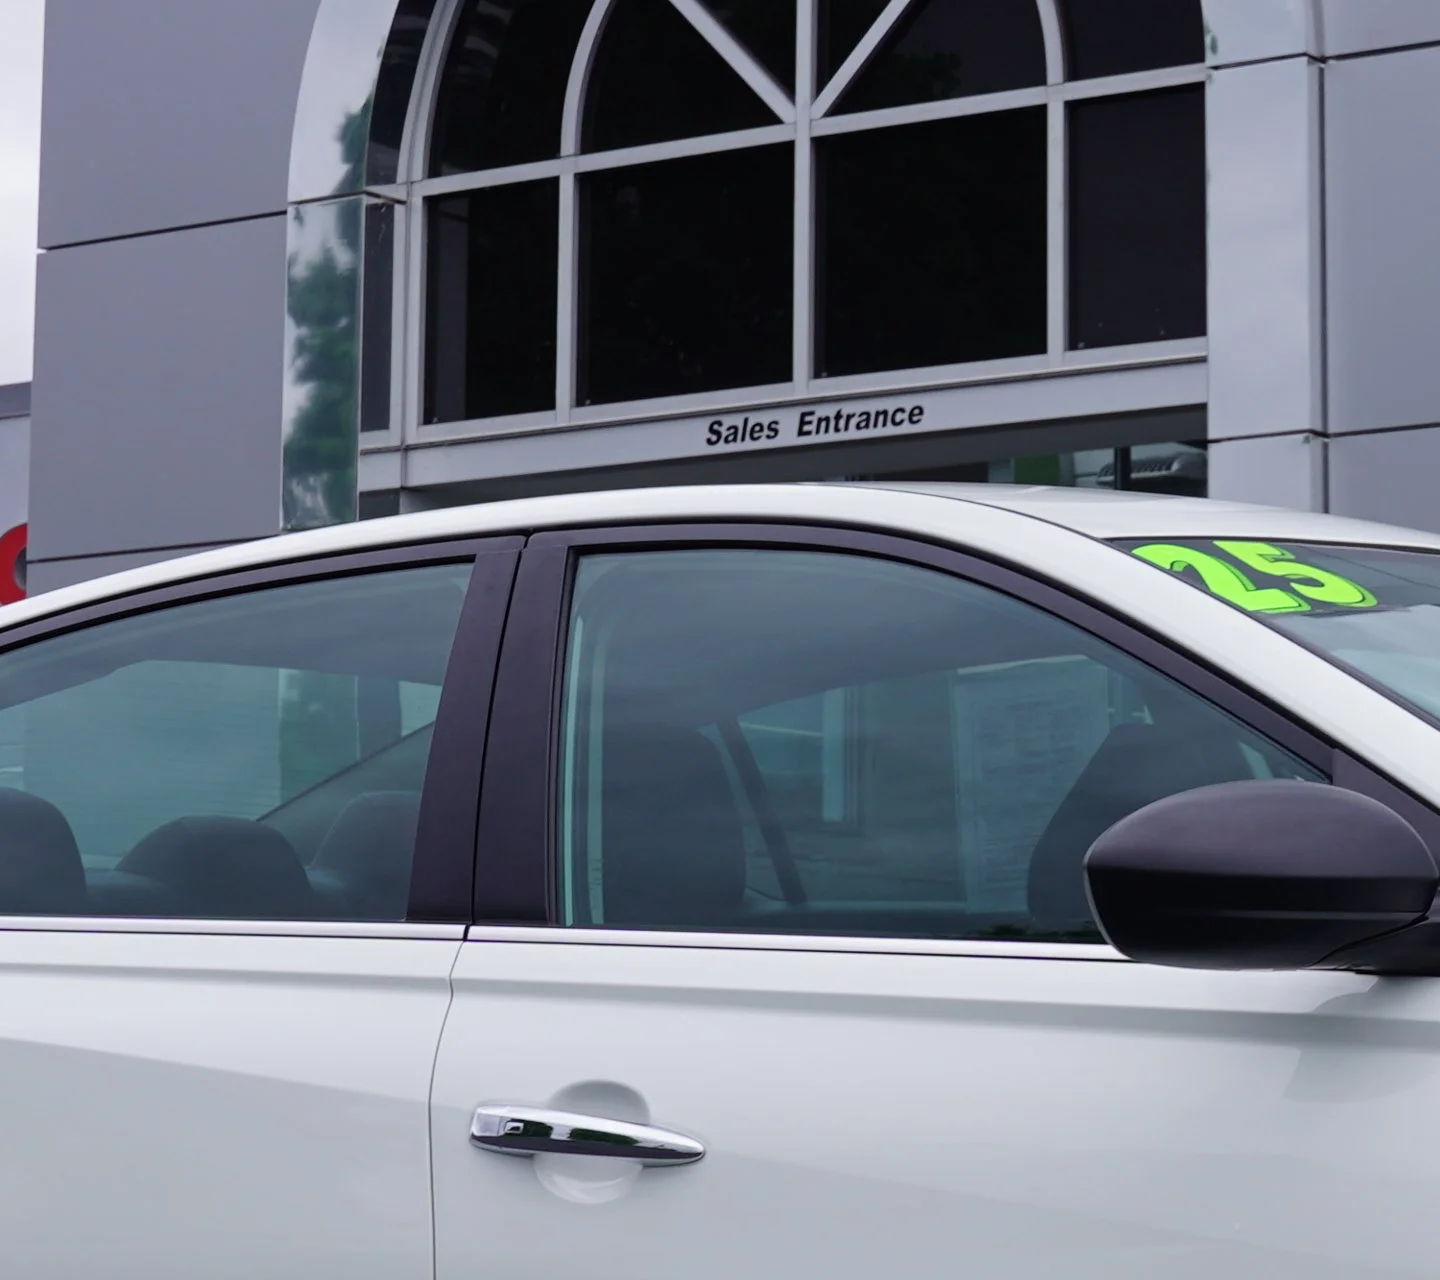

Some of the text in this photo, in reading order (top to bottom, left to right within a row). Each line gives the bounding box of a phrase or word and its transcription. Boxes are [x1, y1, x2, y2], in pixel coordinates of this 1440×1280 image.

[705, 404, 926, 447] Sales Entrance
[1130, 540, 1379, 614] 25
